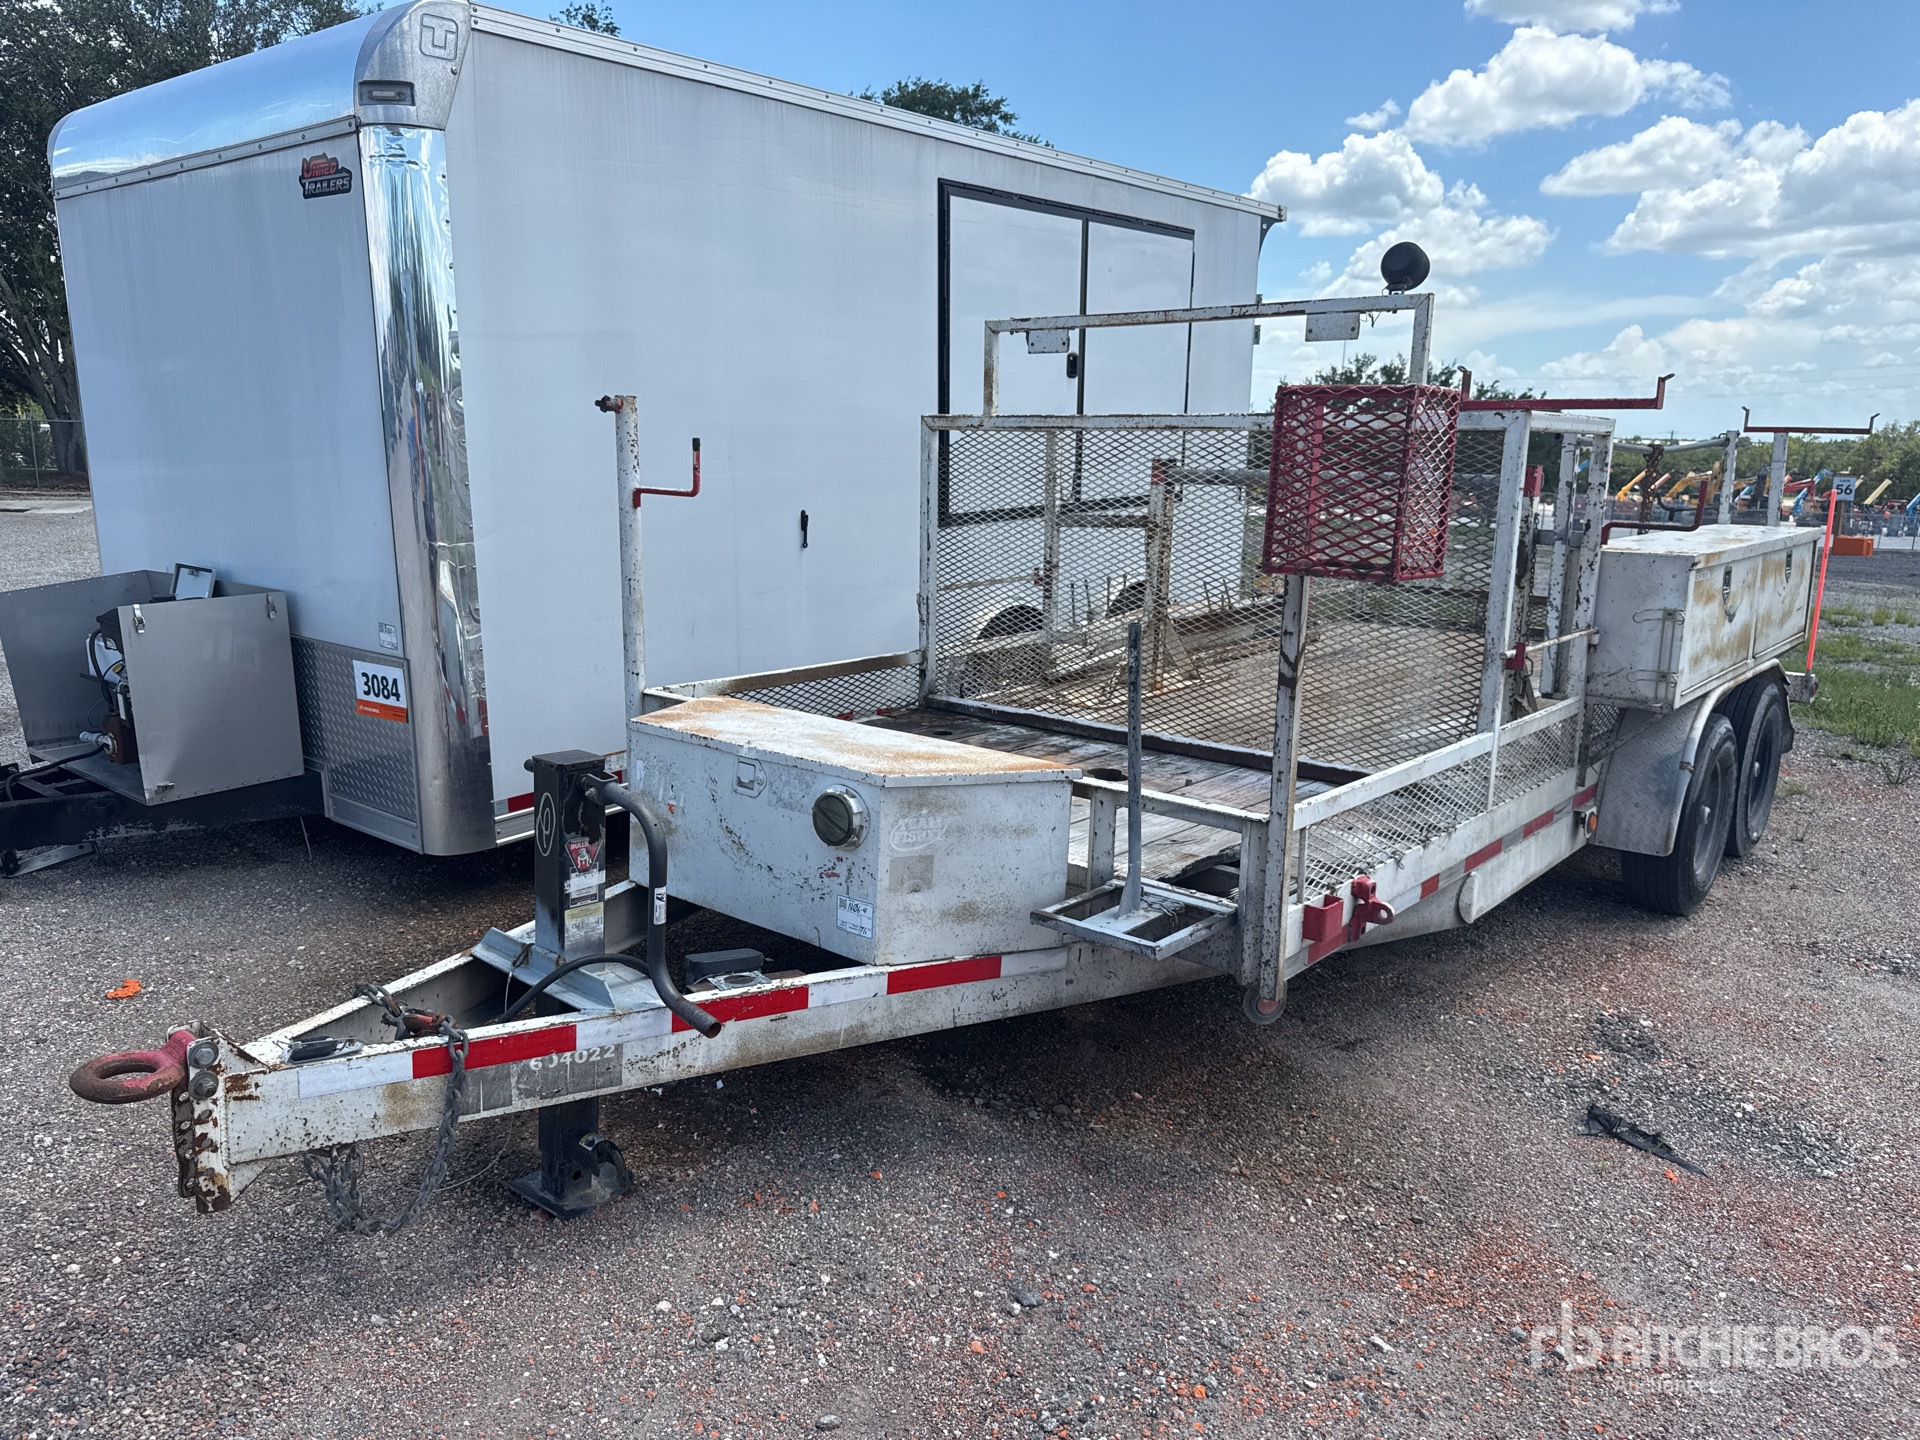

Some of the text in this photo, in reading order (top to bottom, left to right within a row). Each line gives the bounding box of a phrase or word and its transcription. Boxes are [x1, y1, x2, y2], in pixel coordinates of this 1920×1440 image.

[303, 159, 338, 178] UNITED
[301, 173, 351, 196] TRAILERS
[1836, 484, 1853, 495] 56
[361, 672, 401, 701] 3084
